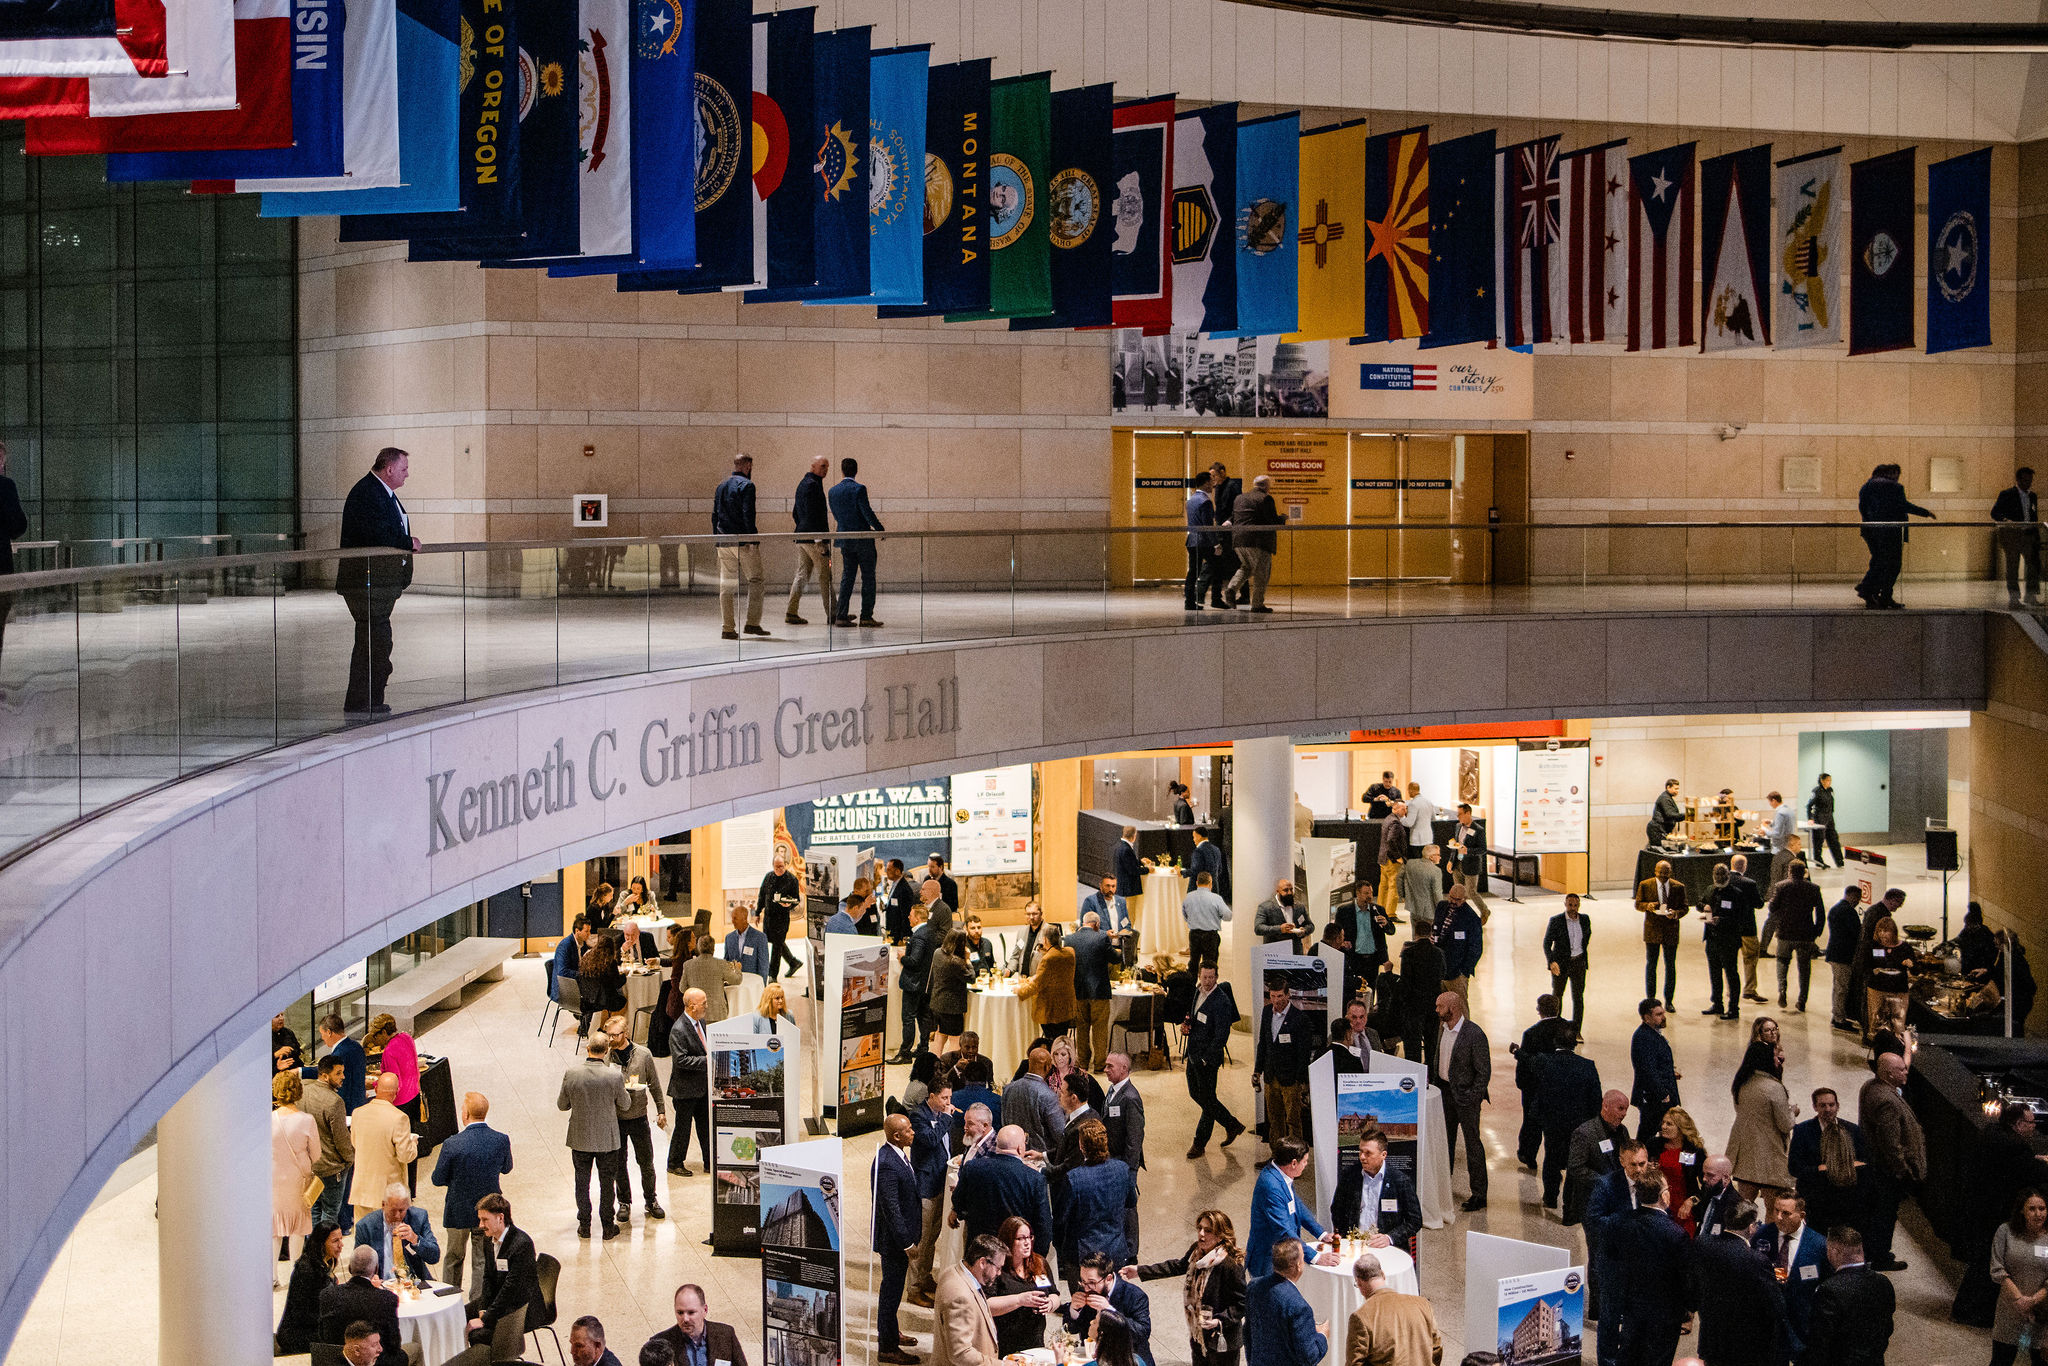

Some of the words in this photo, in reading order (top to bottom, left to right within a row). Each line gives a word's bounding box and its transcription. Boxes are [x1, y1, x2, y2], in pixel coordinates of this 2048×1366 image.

[296, 0, 328, 69] SIN
[485, 24, 505, 58] OF
[715, 95, 725, 107] OF
[475, 70, 503, 185] OREGON
[726, 113, 734, 136] THE
[722, 142, 735, 177] STATE
[889, 129, 909, 171] SOUTH
[884, 175, 911, 225] DAKOTA
[962, 112, 978, 264] MONTANA
[1017, 165, 1031, 184] THE
[1024, 188, 1034, 219] STATE
[1450, 364, 1472, 373] our
[425, 736, 577, 858] Kenneth
[588, 729, 627, 801] C.
[639, 703, 762, 787] Griffin
[774, 697, 874, 760] Great
[883, 675, 963, 743] Hall
[885, 785, 945, 804] WAR
[829, 834, 856, 842] BATTLE
